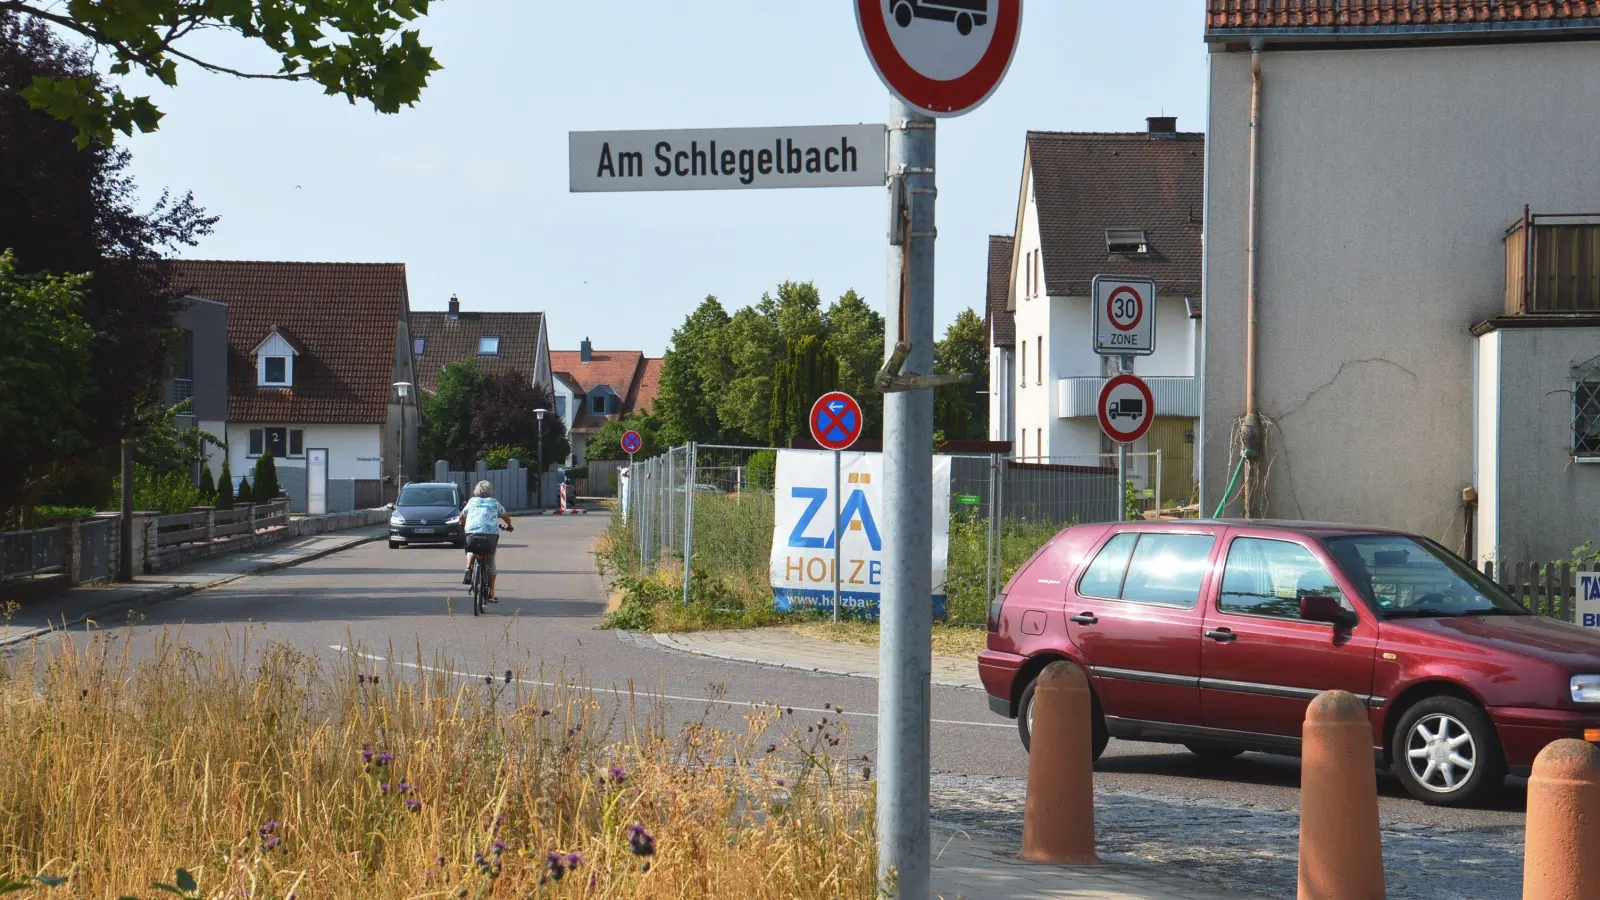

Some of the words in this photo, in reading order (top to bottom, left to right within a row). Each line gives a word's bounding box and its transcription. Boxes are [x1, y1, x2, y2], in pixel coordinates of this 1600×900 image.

[597, 142, 643, 177] Am
[654, 136, 857, 184] Schlegelbach
[1114, 298, 1135, 319] 30
[1110, 333, 1138, 345] ZONE
[272, 432, 280, 442] 2
[787, 472, 882, 551] ZÄ
[785, 556, 881, 585] HOLZB
[1581, 575, 1600, 600] TA
[787, 593, 881, 609] www.hlzbau-
